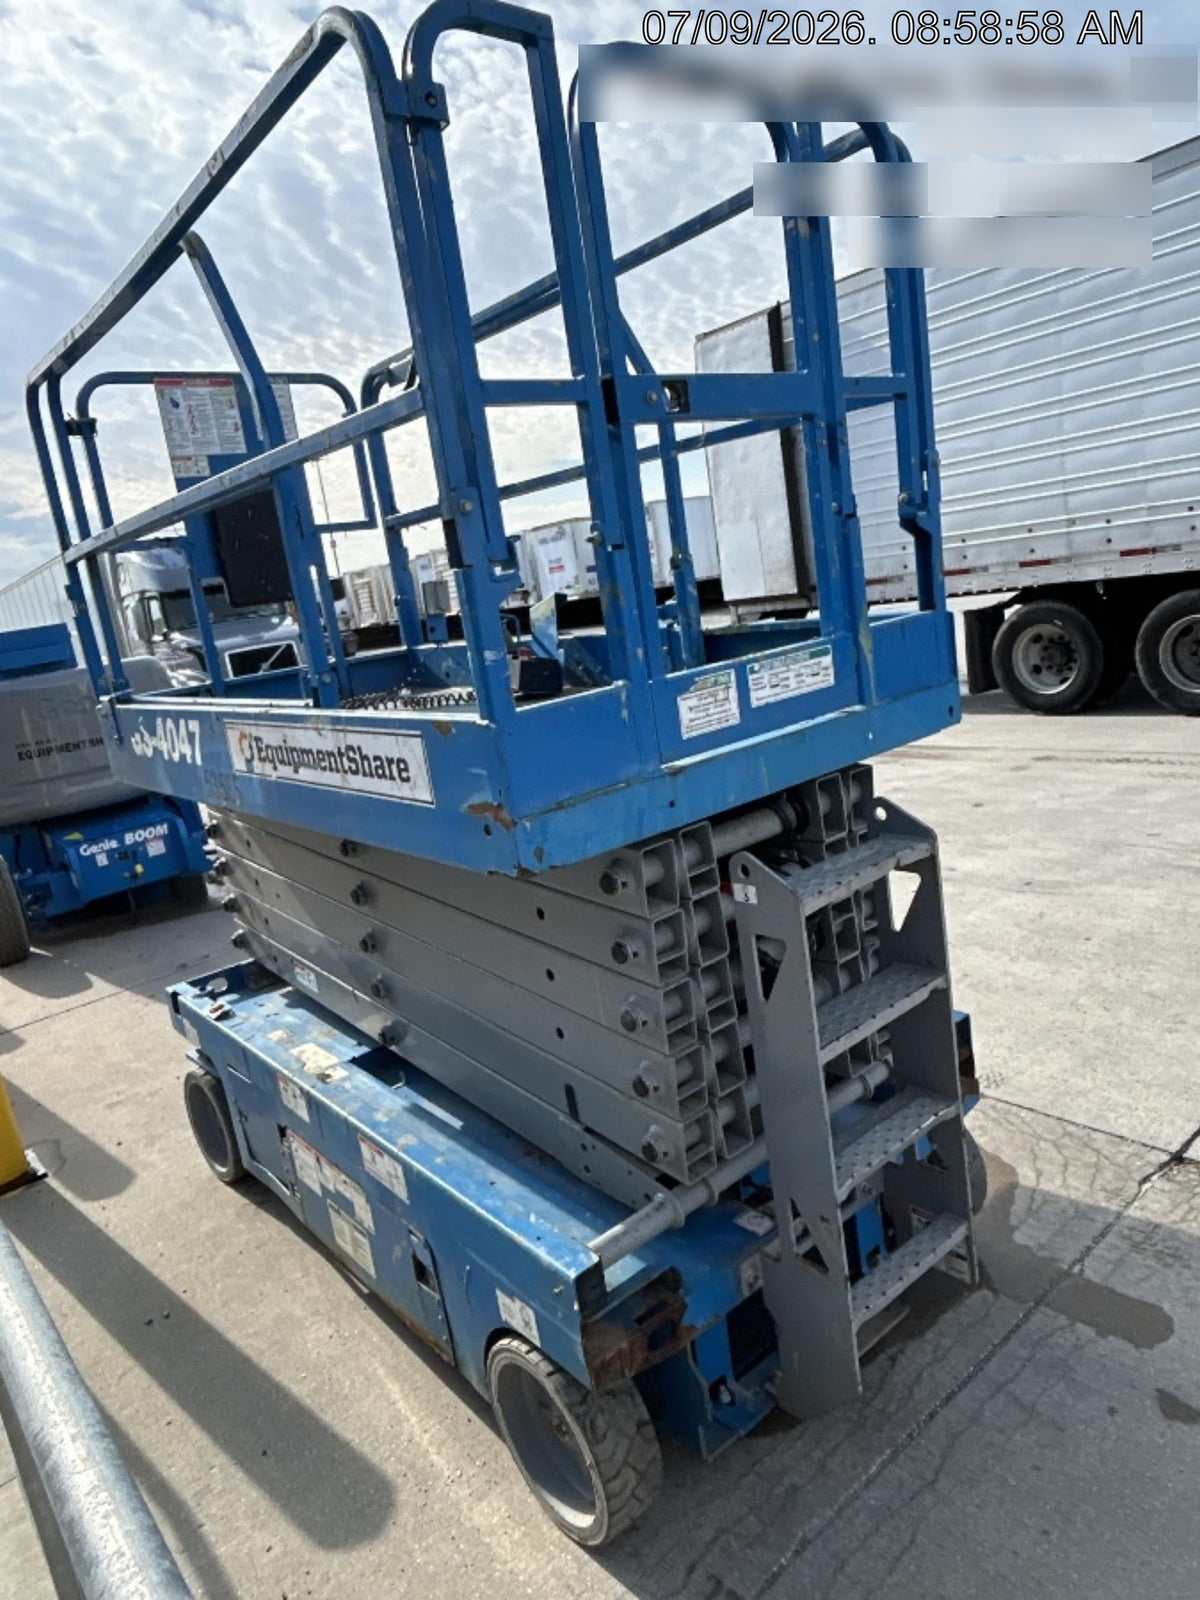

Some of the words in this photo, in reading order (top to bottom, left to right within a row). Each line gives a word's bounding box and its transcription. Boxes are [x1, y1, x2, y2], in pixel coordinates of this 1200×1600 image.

[253, 735, 411, 783] EquipmentShare
[79, 839, 118, 856] Genie
[124, 823, 168, 845] BOOM
